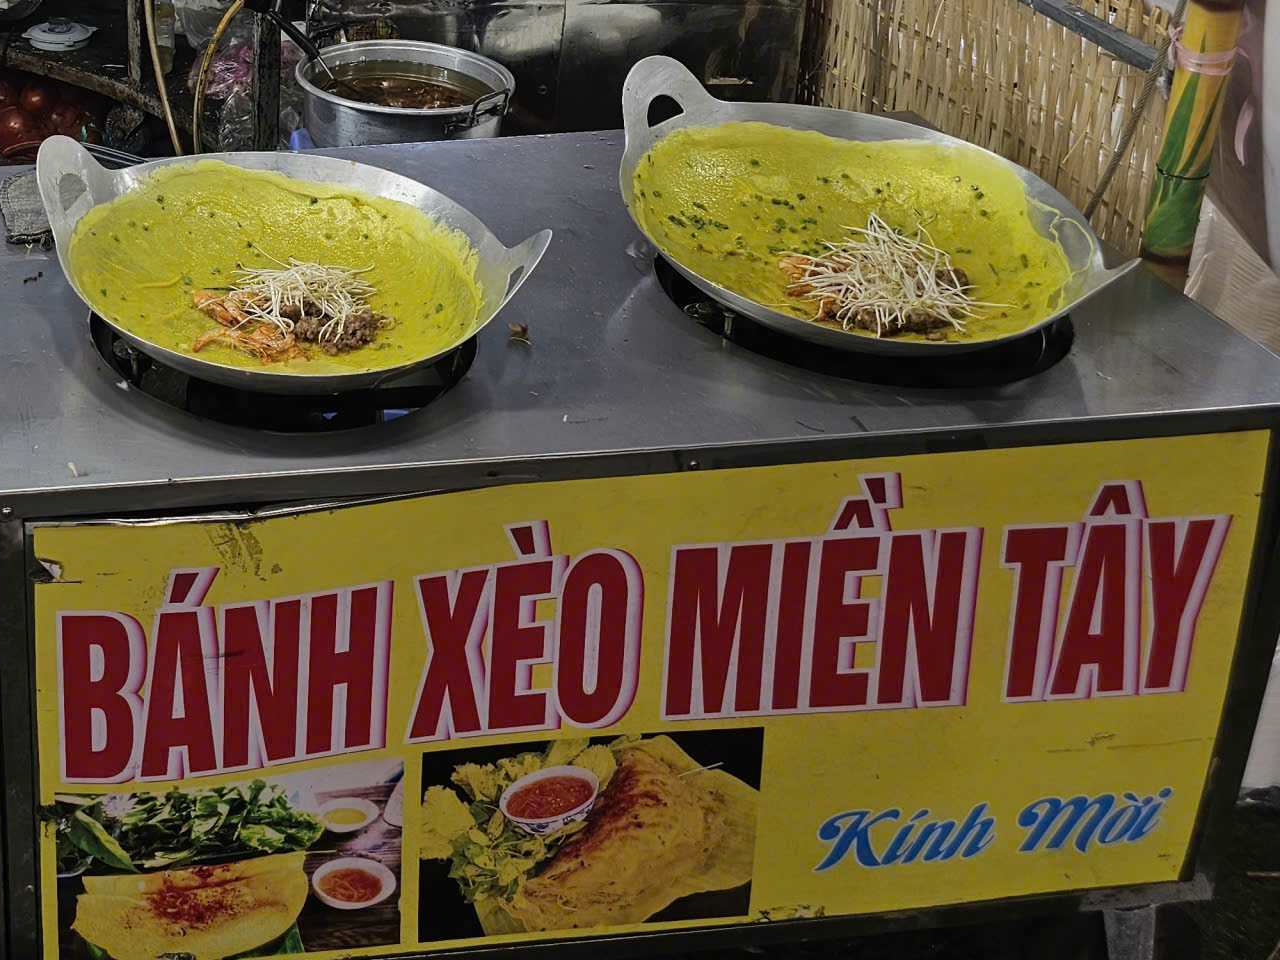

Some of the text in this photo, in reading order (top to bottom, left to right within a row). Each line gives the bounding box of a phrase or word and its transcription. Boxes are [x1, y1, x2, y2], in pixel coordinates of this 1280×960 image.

[56, 472, 1233, 784] BÁNH XÈO MIỀN TÂY
[814, 787, 1174, 872] Kính Mời
